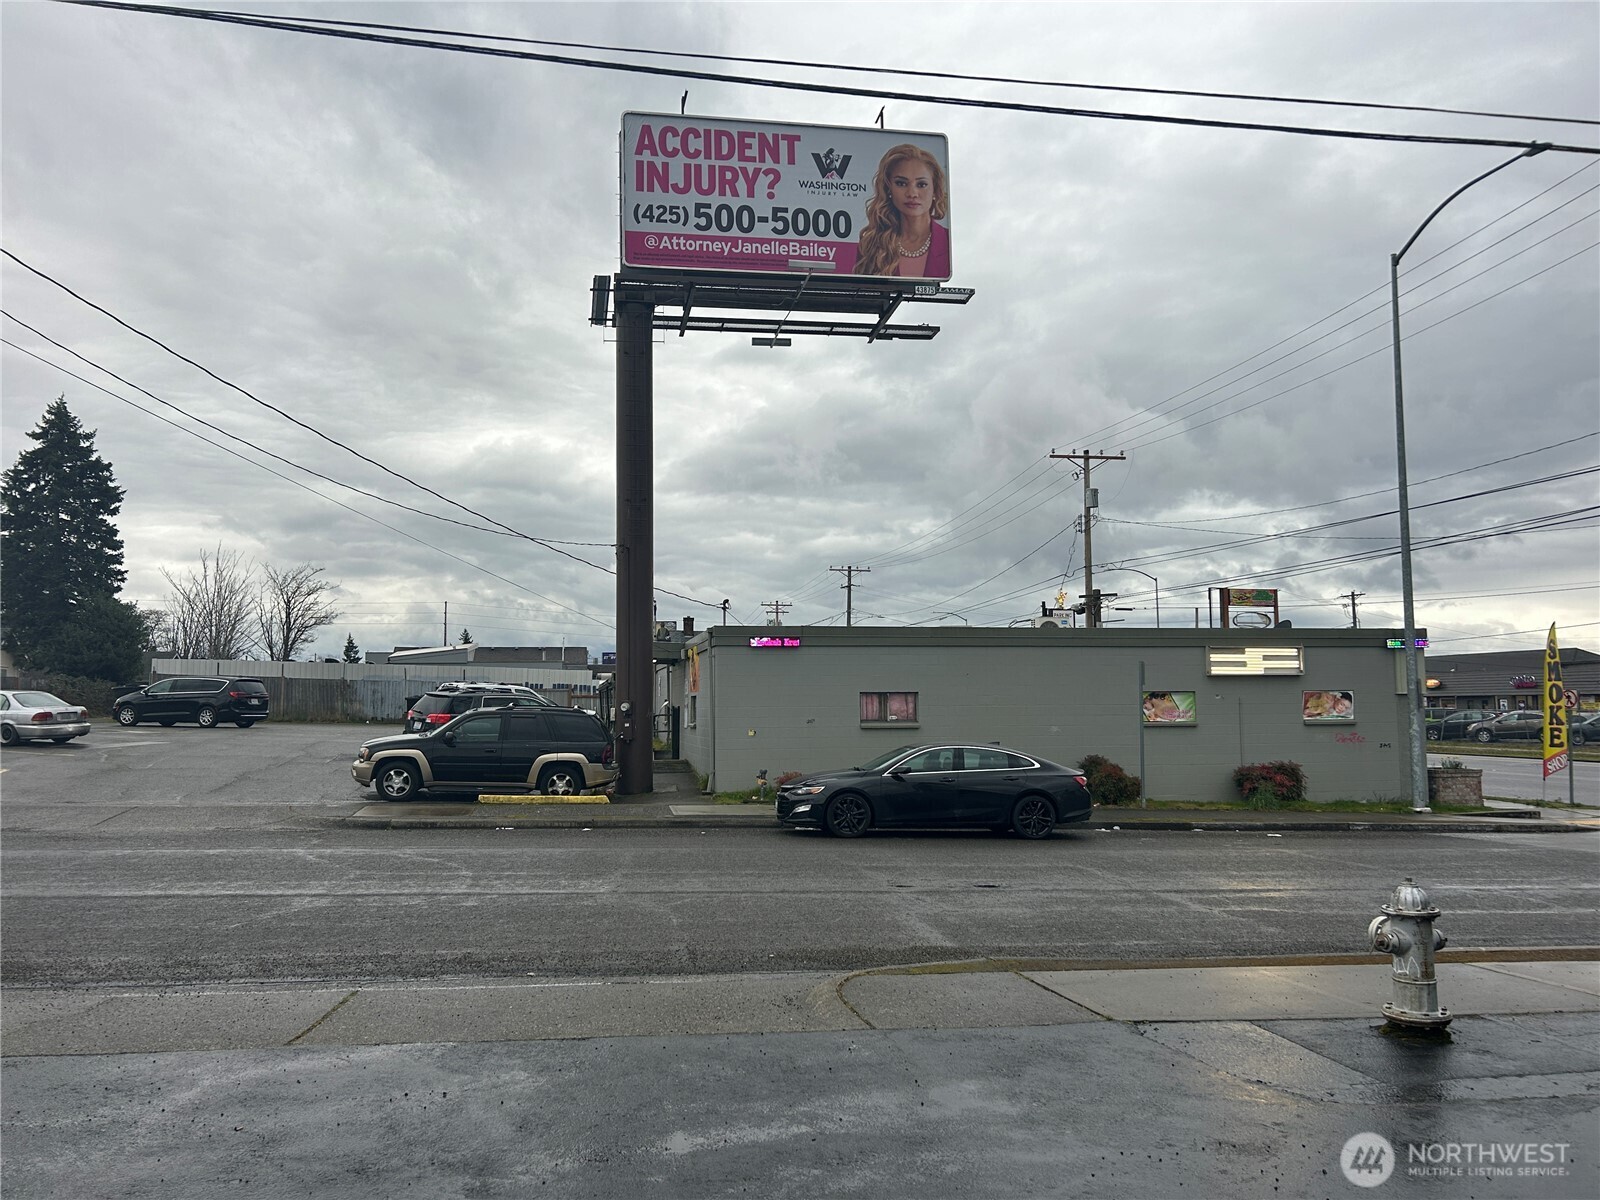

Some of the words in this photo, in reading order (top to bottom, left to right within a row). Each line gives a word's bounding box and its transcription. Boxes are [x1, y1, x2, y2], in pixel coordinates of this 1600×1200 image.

[634, 124, 801, 165] ACCIDENT
[635, 159, 782, 200] INJURY?
[798, 180, 867, 193] WASHINGTON
[633, 203, 689, 227] (425)
[694, 202, 852, 239] 500-5000
[644, 235, 836, 261] @AttorneyJanelleBailey
[915, 286, 935, 294] 43875
[1547, 639, 1564, 748] SMOKE
[1547, 753, 1569, 774] SHOP
